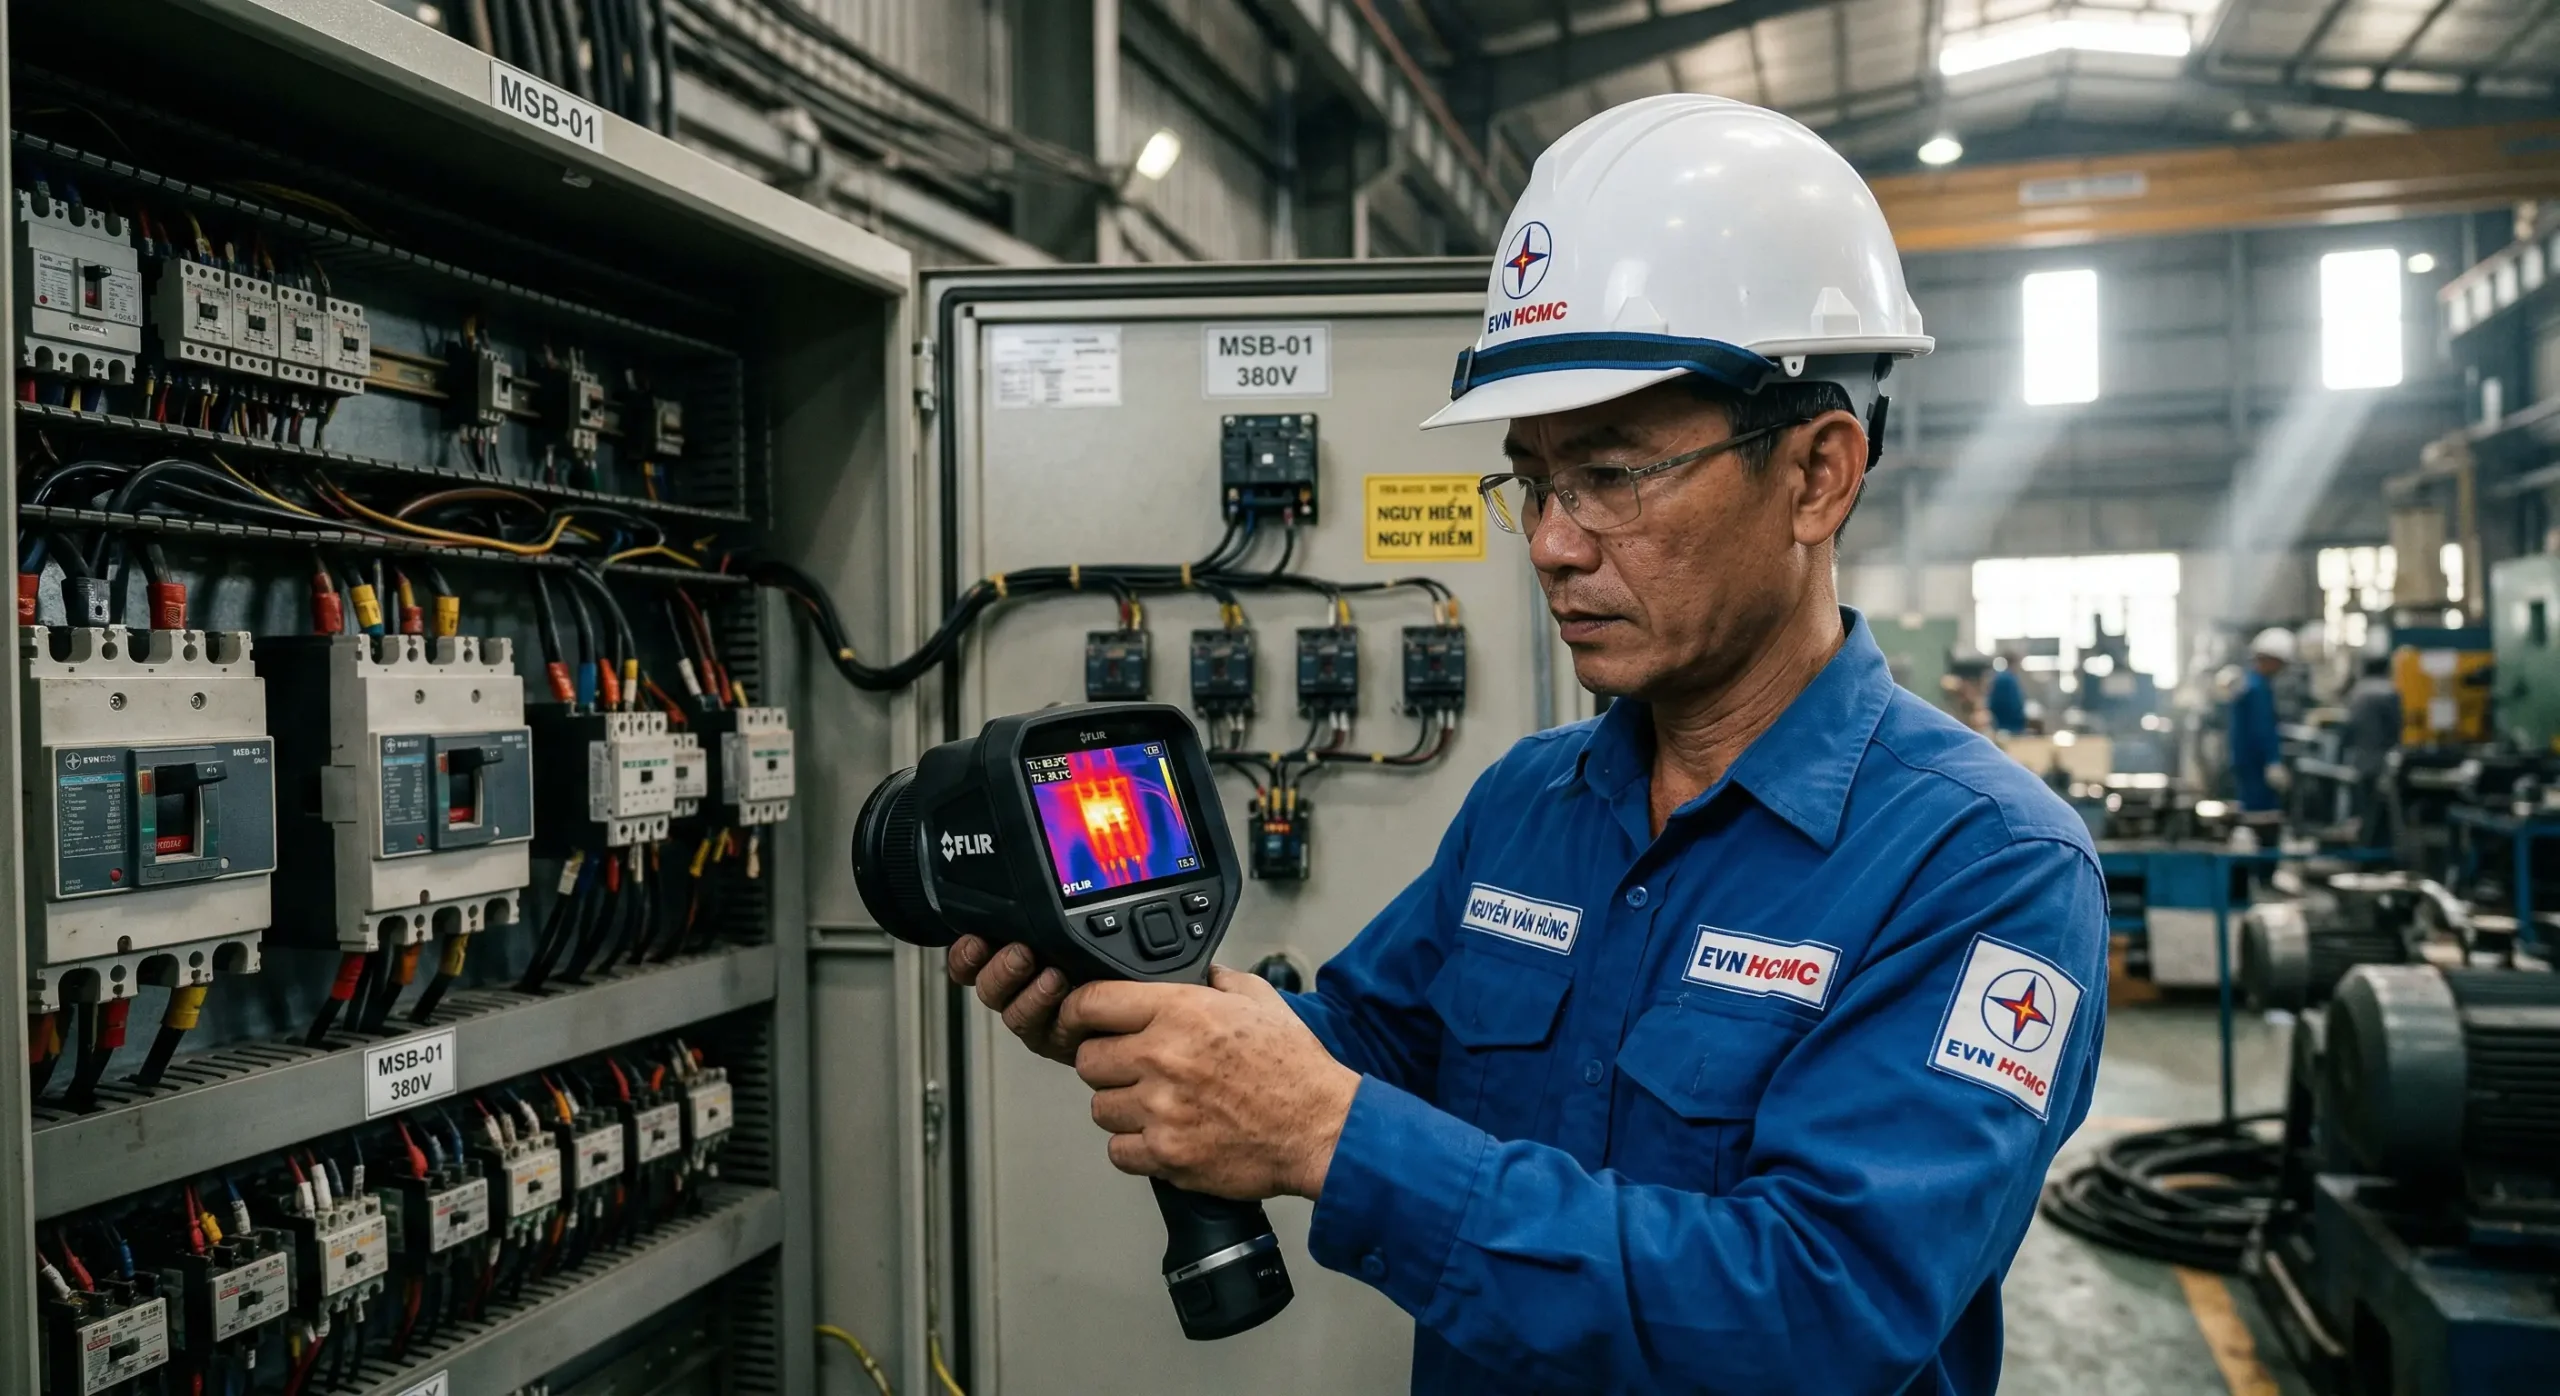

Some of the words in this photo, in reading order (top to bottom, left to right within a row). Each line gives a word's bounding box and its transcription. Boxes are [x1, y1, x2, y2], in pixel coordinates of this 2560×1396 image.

[501, 74, 593, 144] MSB-01
[1219, 335, 1312, 356] MSB-01
[1237, 366, 1298, 387] 380V
[1377, 505, 1424, 521] NGUY
[1377, 530, 1424, 547] NGUY
[1086, 731, 1107, 741] FLIR
[954, 833, 995, 856] FLIR
[1070, 879, 1092, 892] FLIR
[1512, 907, 1536, 934] VĂN
[1534, 912, 1569, 941] HÙNG
[379, 1043, 442, 1076] MSB-01
[1945, 1038, 1995, 1068] EVN
[1997, 1057, 2047, 1097] HCMC
[391, 1072, 432, 1100] 380V
